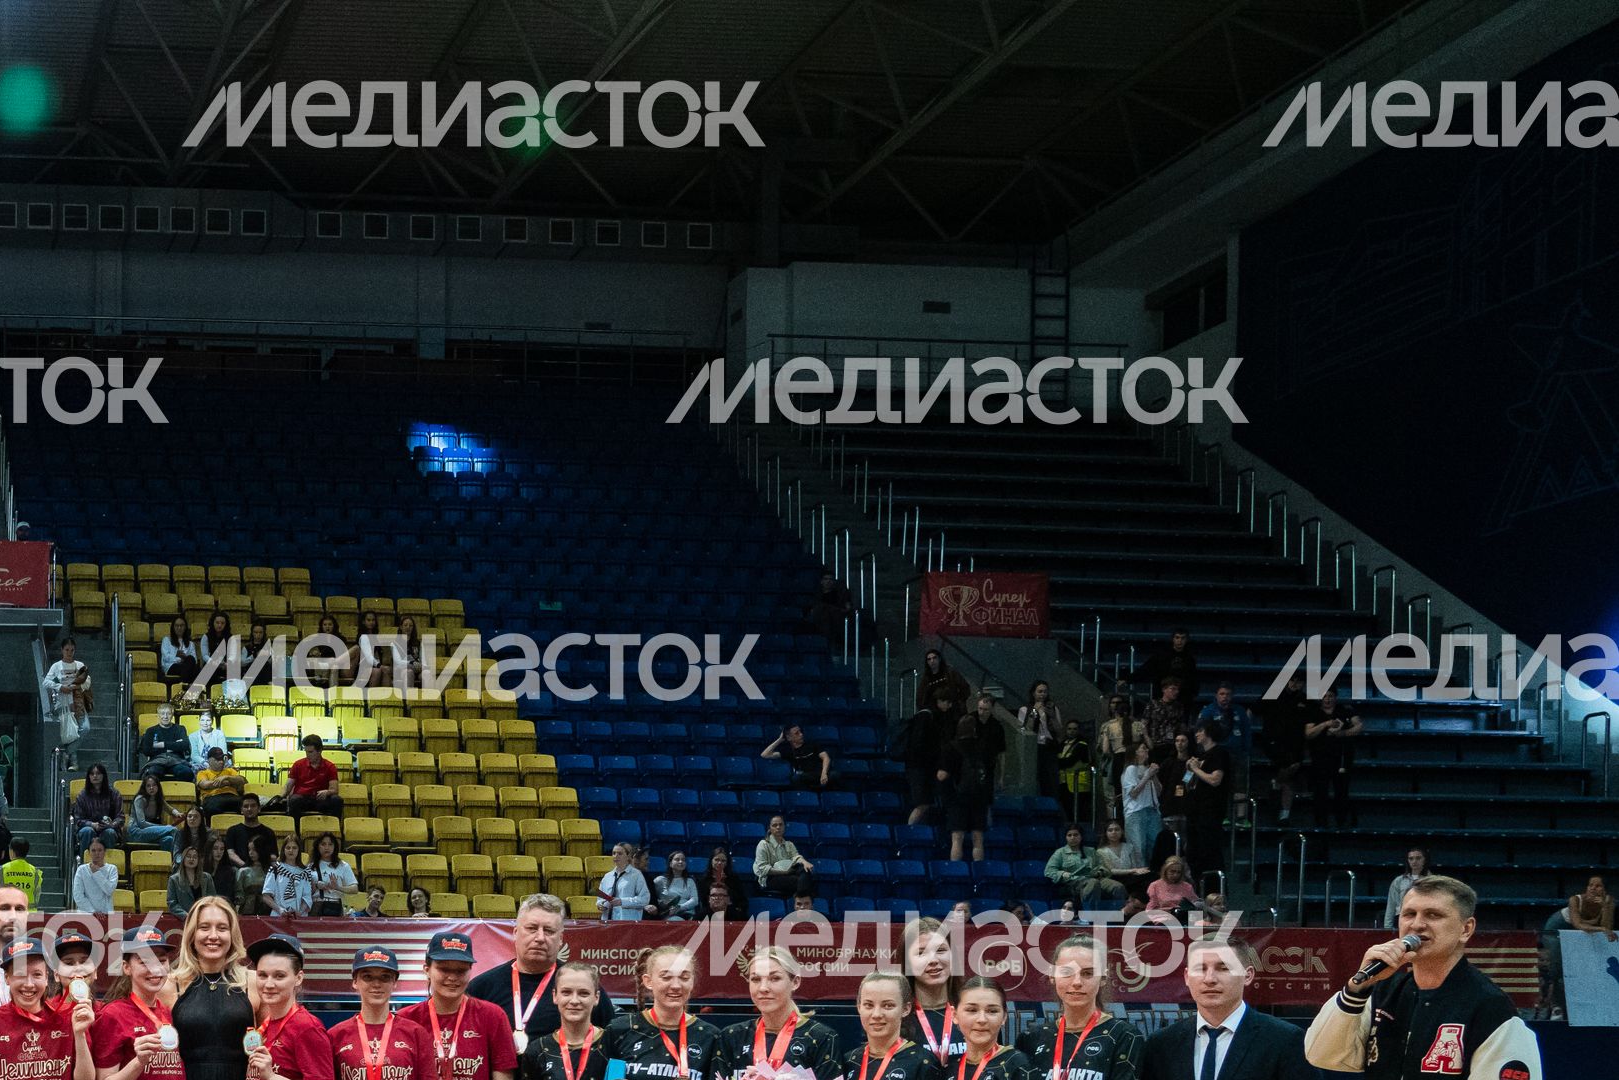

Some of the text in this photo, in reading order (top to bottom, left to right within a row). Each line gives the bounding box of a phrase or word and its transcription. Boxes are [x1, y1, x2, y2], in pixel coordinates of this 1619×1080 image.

[971, 607, 1039, 626] ФИНАЛ
[581, 948, 640, 960] МИНСПО
[796, 947, 898, 959] МИНОБРНАУКИ
[591, 964, 636, 975] ОССИИ
[985, 959, 1022, 973] РФБ
[1253, 982, 1331, 990] ОССИИ
